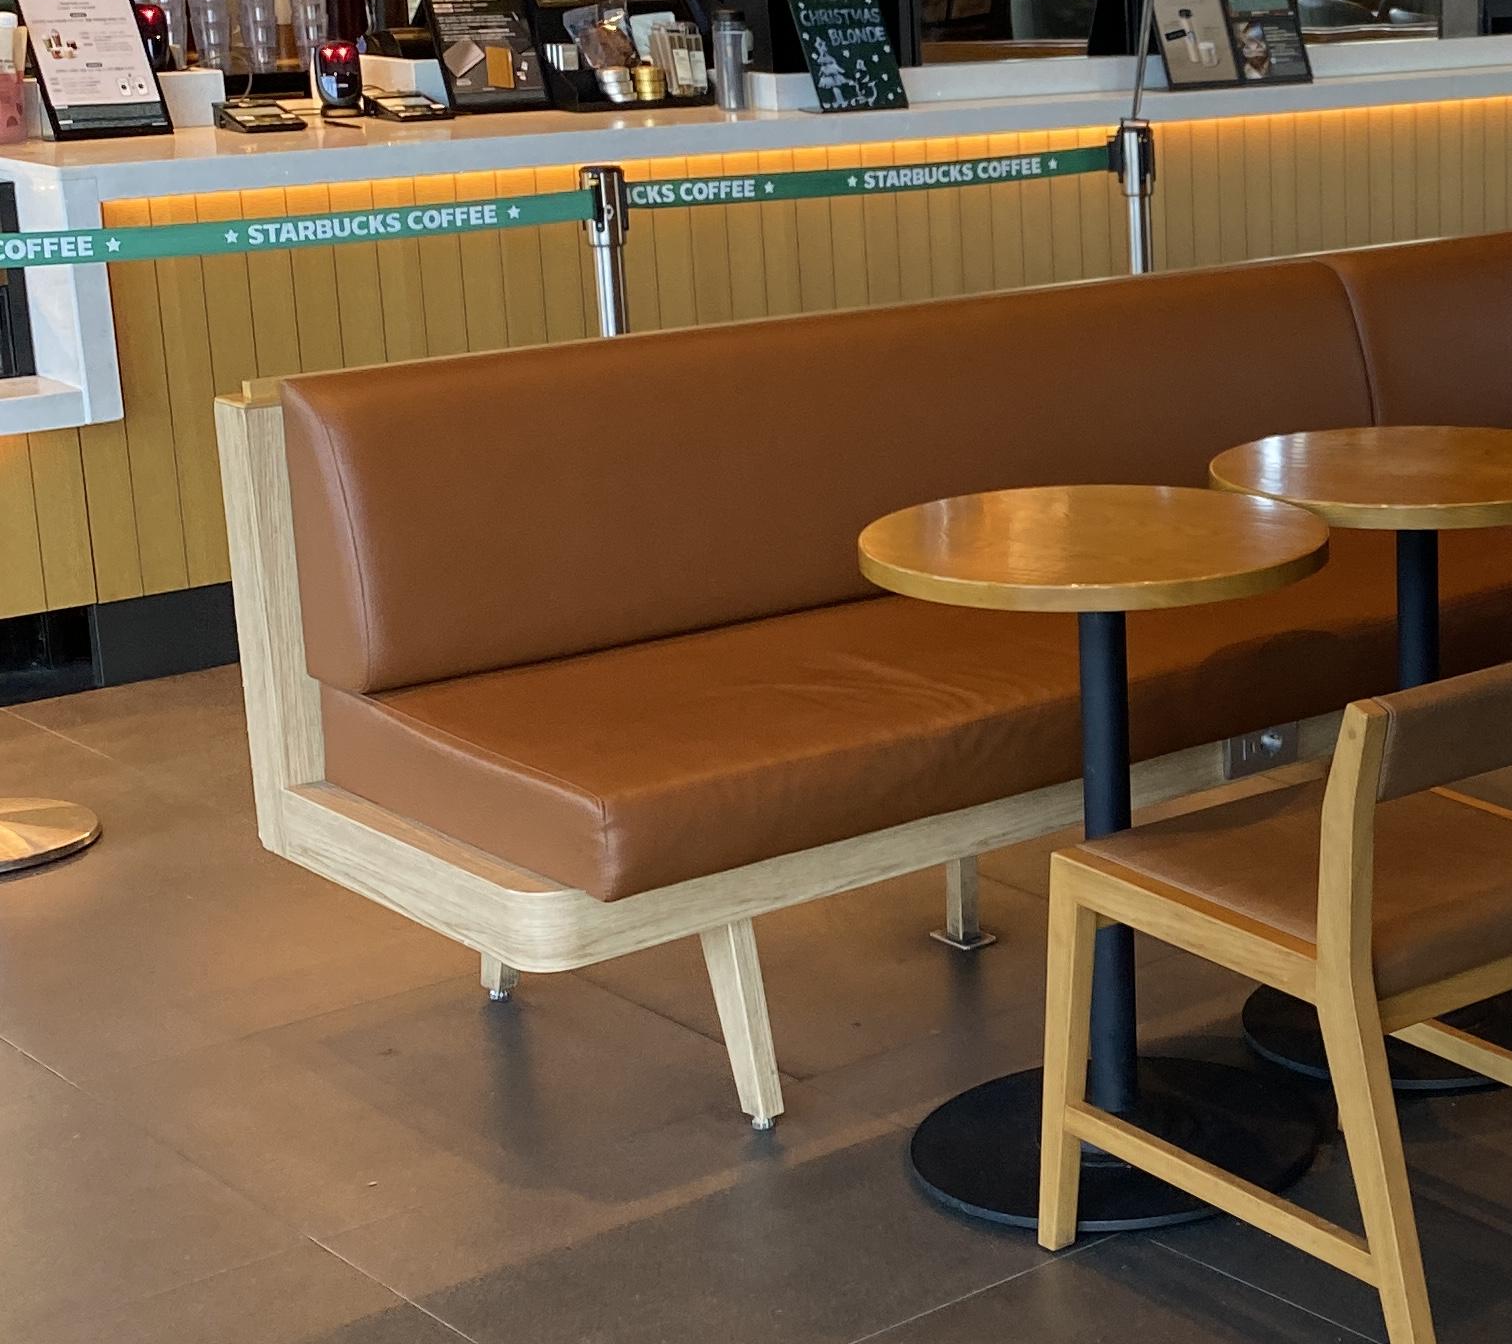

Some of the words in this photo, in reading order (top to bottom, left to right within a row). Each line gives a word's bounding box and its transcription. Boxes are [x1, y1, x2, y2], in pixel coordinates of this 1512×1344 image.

[800, 8, 881, 26] CHRISTMAS
[828, 26, 886, 46] BLONDE
[864, 163, 974, 190] STARBUCKS
[977, 157, 1042, 180] COFFEE
[679, 179, 756, 202] COFFEE
[247, 213, 402, 246] STARBUCKS
[406, 204, 498, 231] COFFEE
[0, 235, 95, 262] OFFEE
